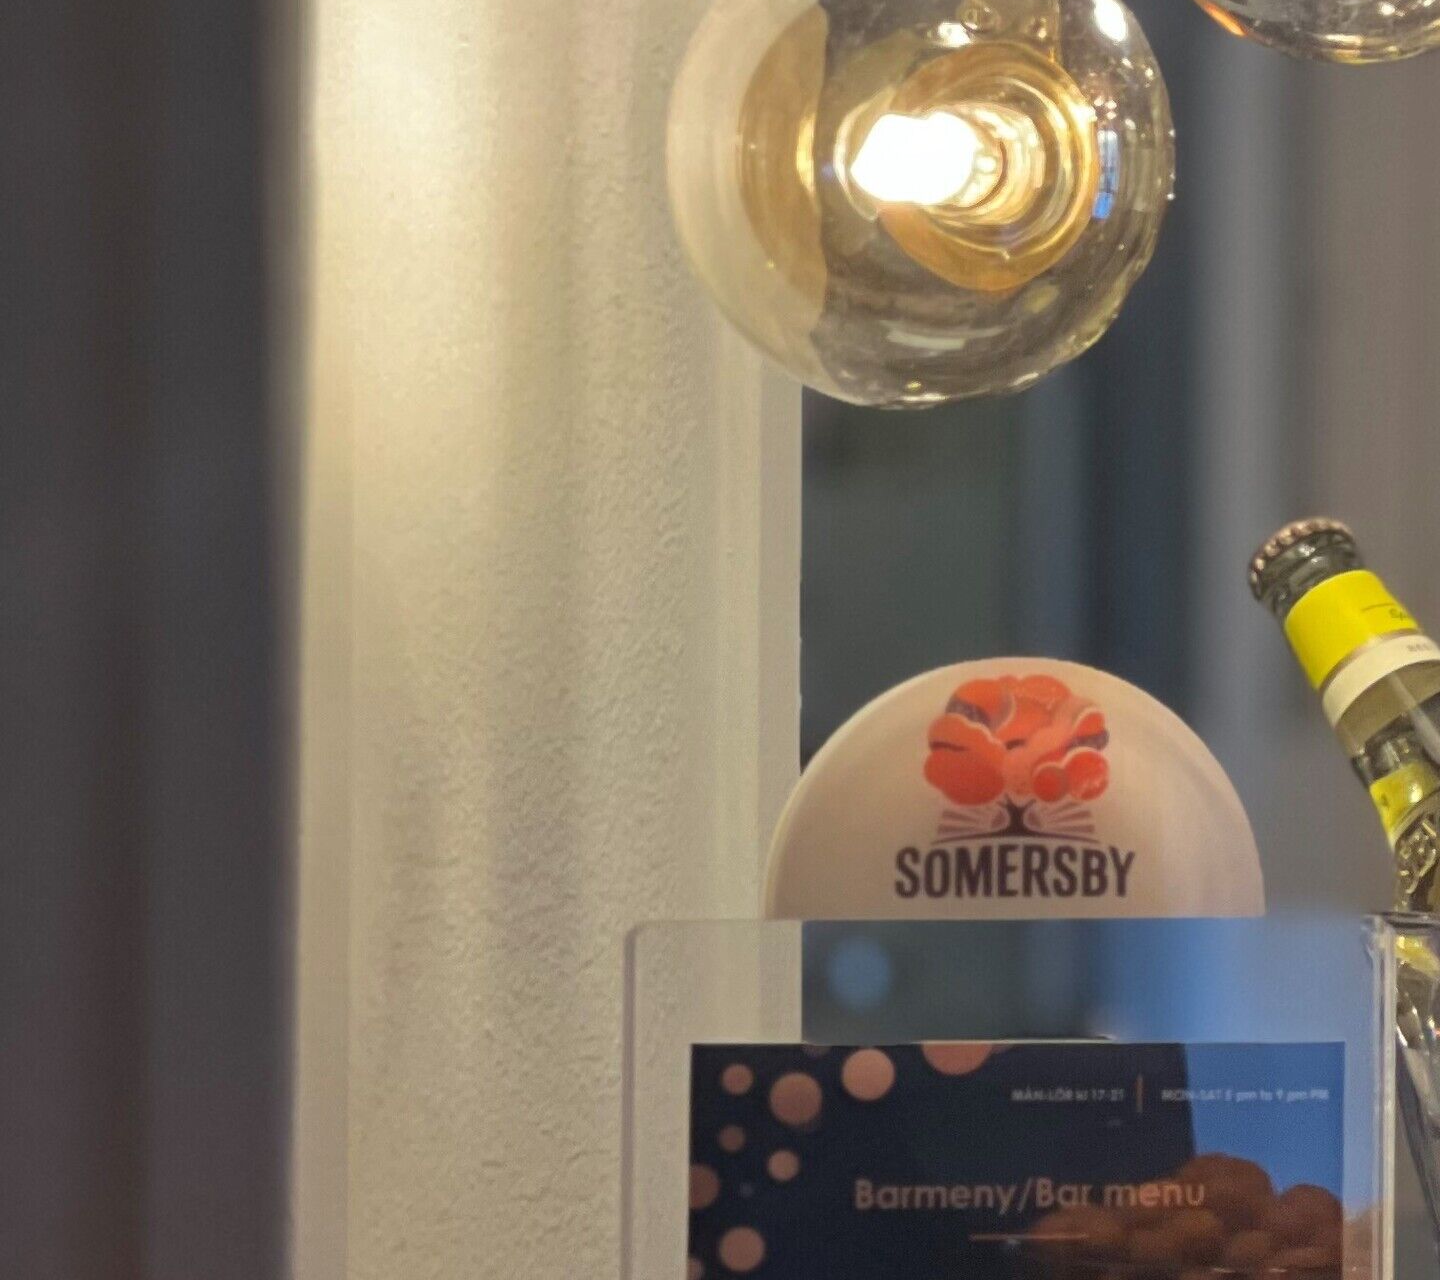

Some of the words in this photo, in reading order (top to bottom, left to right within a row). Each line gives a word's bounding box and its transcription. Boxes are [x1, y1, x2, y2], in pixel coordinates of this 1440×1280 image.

[894, 843, 1135, 899] SOMERSBY
[853, 1176, 1097, 1215] Barmeny/Bar
[1104, 1179, 1207, 1208] menu
